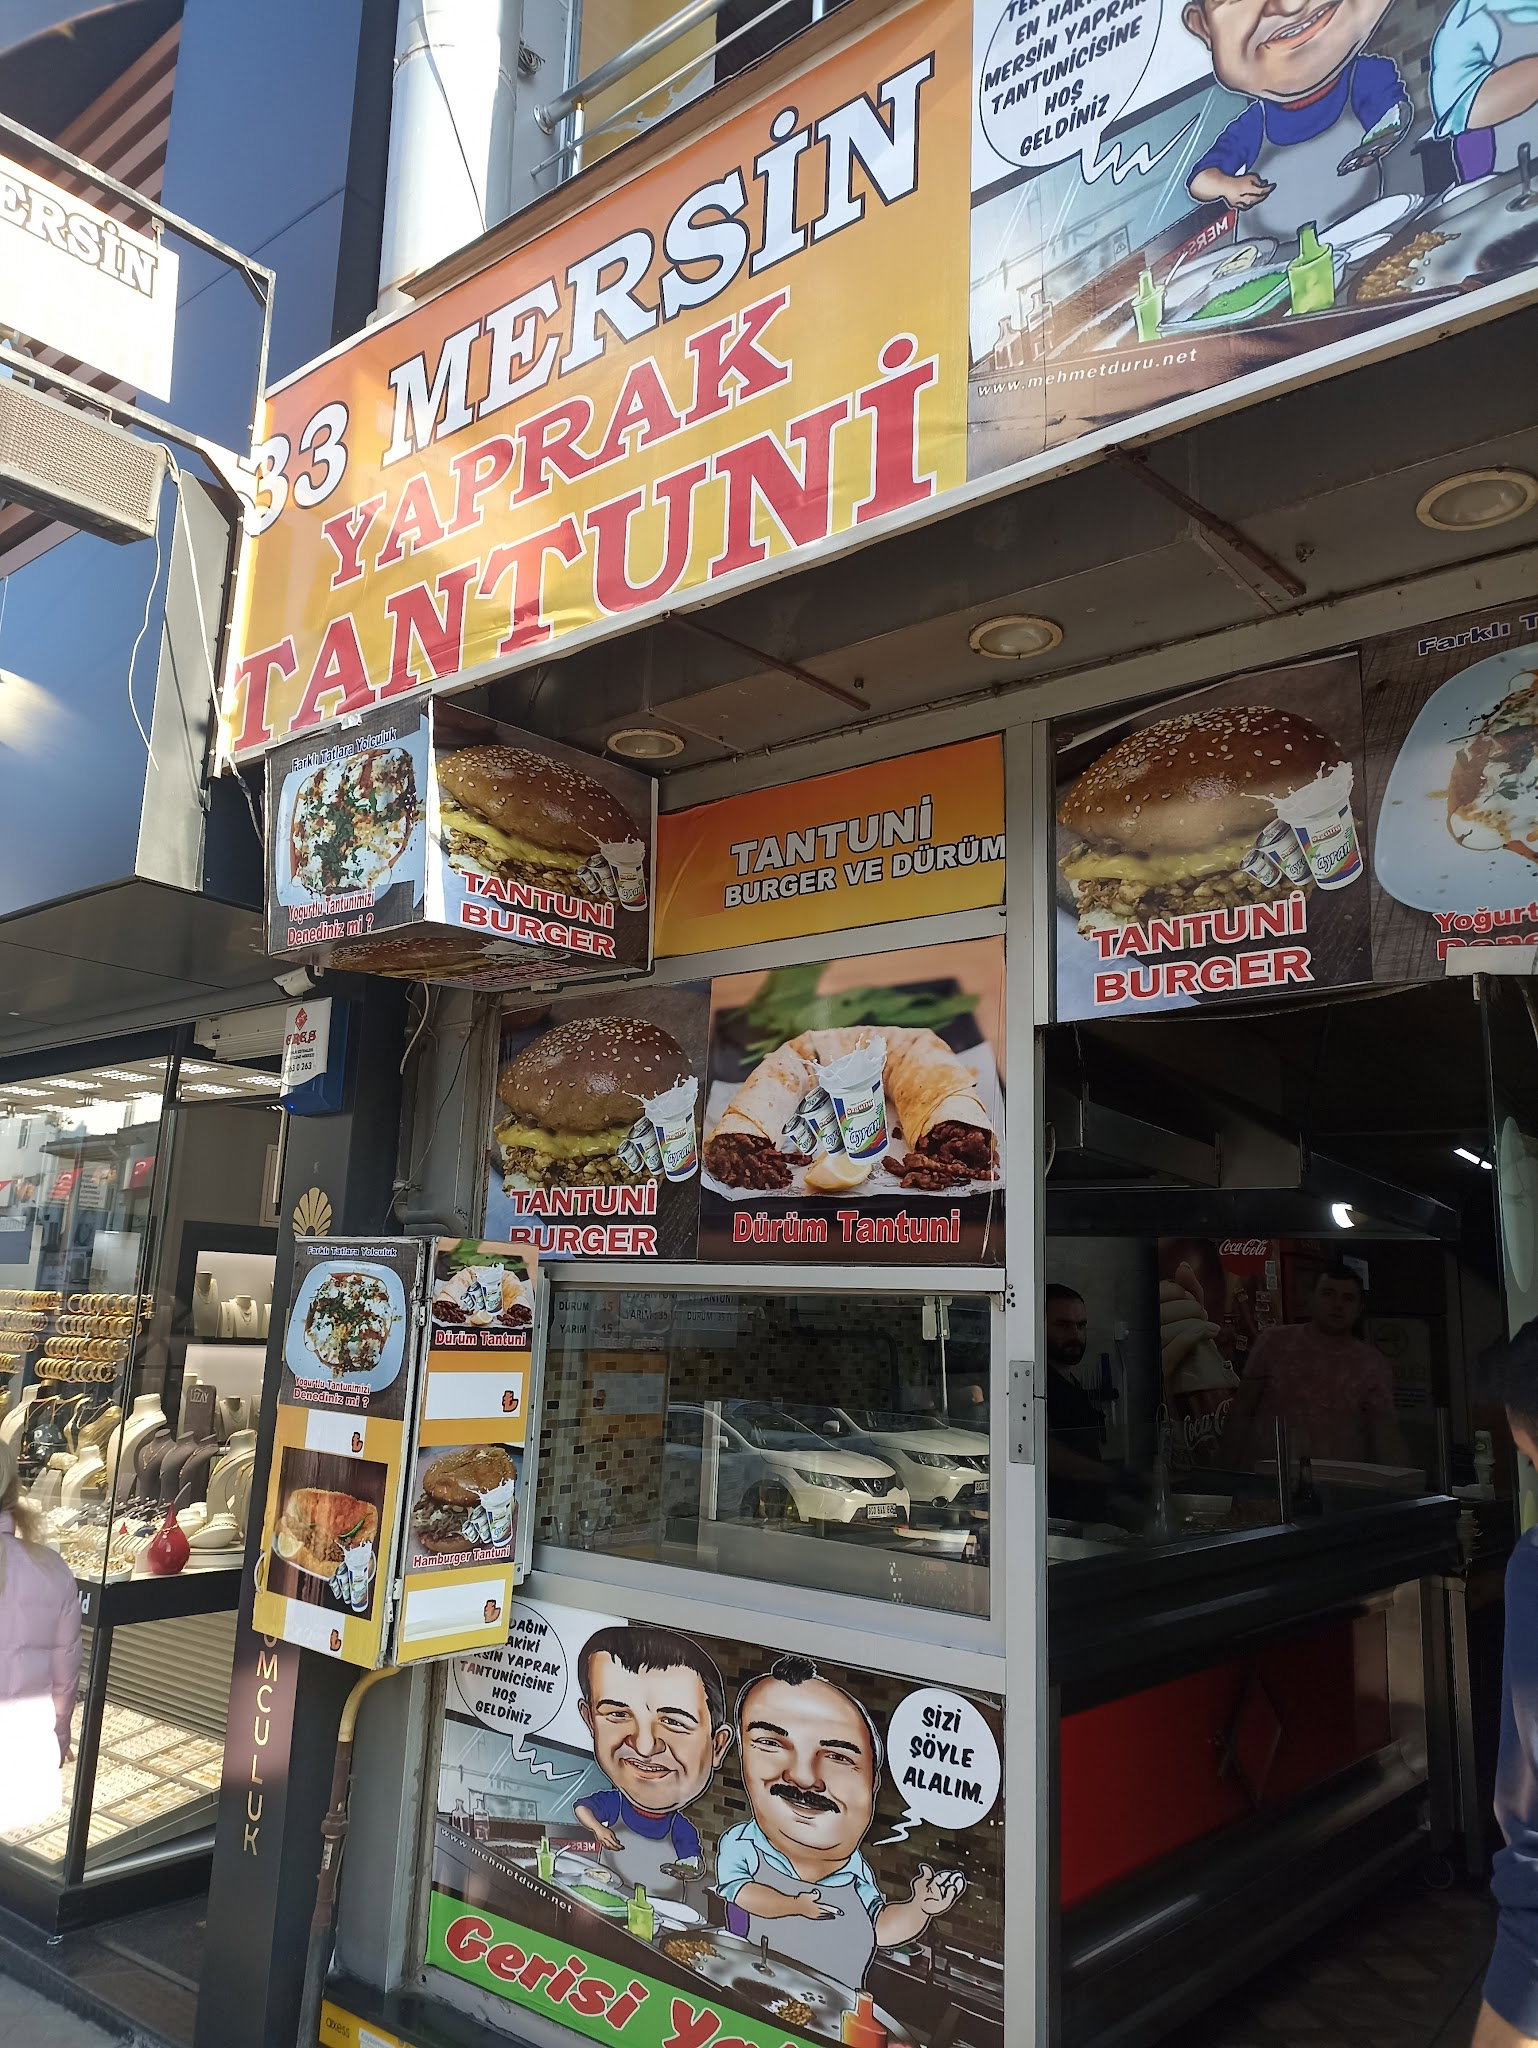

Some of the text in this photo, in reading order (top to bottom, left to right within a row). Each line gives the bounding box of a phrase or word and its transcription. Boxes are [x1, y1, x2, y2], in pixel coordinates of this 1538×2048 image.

[1016, 16, 1040, 45] EN
[984, 35, 1028, 92] MERSİN
[991, 15, 1143, 115] TANTUNİCİSİNE
[1044, 79, 1084, 116] HOŞ
[1020, 94, 1110, 157] GELDİNİZ
[237, 50, 936, 537] 33 MERSİN
[978, 348, 1198, 397] www.mehmetduru.net
[321, 285, 793, 592] YAPRAK
[234, 333, 938, 753] TANTUNİ
[1418, 622, 1511, 656] Farklı
[320, 743, 355, 765] Tatlara
[356, 727, 398, 752] Yolculuk
[730, 794, 934, 877] TANTUNİ
[724, 834, 1006, 909] BURGER VE DÜRÜM
[325, 887, 376, 916] Tantunimizi
[459, 869, 616, 931] TANTUNİ
[287, 912, 375, 947] Denediniz mi ?
[460, 900, 617, 959] BURGER
[1092, 890, 1309, 962] TANTUNİ
[1094, 946, 1315, 1006] BURGER
[509, 1178, 659, 1218] TANTUNİ
[509, 1224, 659, 1257] BURGER
[733, 1207, 962, 1244] Dürüm Tantuni
[331, 1246, 360, 1256] Tatlara
[360, 1247, 398, 1257] Yolculuk
[1219, 1238, 1269, 1257] Coca-Cola
[435, 1329, 527, 1346] Dürüm Tantuni
[293, 1388, 370, 1409] Denediniz mi ?
[327, 1379, 371, 1395] Tantunimizi
[1184, 1399, 1234, 1449] Coca-C
[413, 1545, 511, 1569] Hamburger Tantuni
[460, 1660, 554, 1694] TANTUNİCİSİNE
[508, 1653, 561, 1677] YAPRAK
[475, 1700, 532, 1726] GELDİNİZ
[491, 1686, 517, 1704] HOŞ
[922, 1704, 962, 1734] SİZİ
[909, 1732, 975, 1768] ŞÖYLE
[903, 1766, 984, 1804] ALALIM.
[445, 1915, 650, 2030] Gerisi
[325, 2017, 350, 2039] axess
